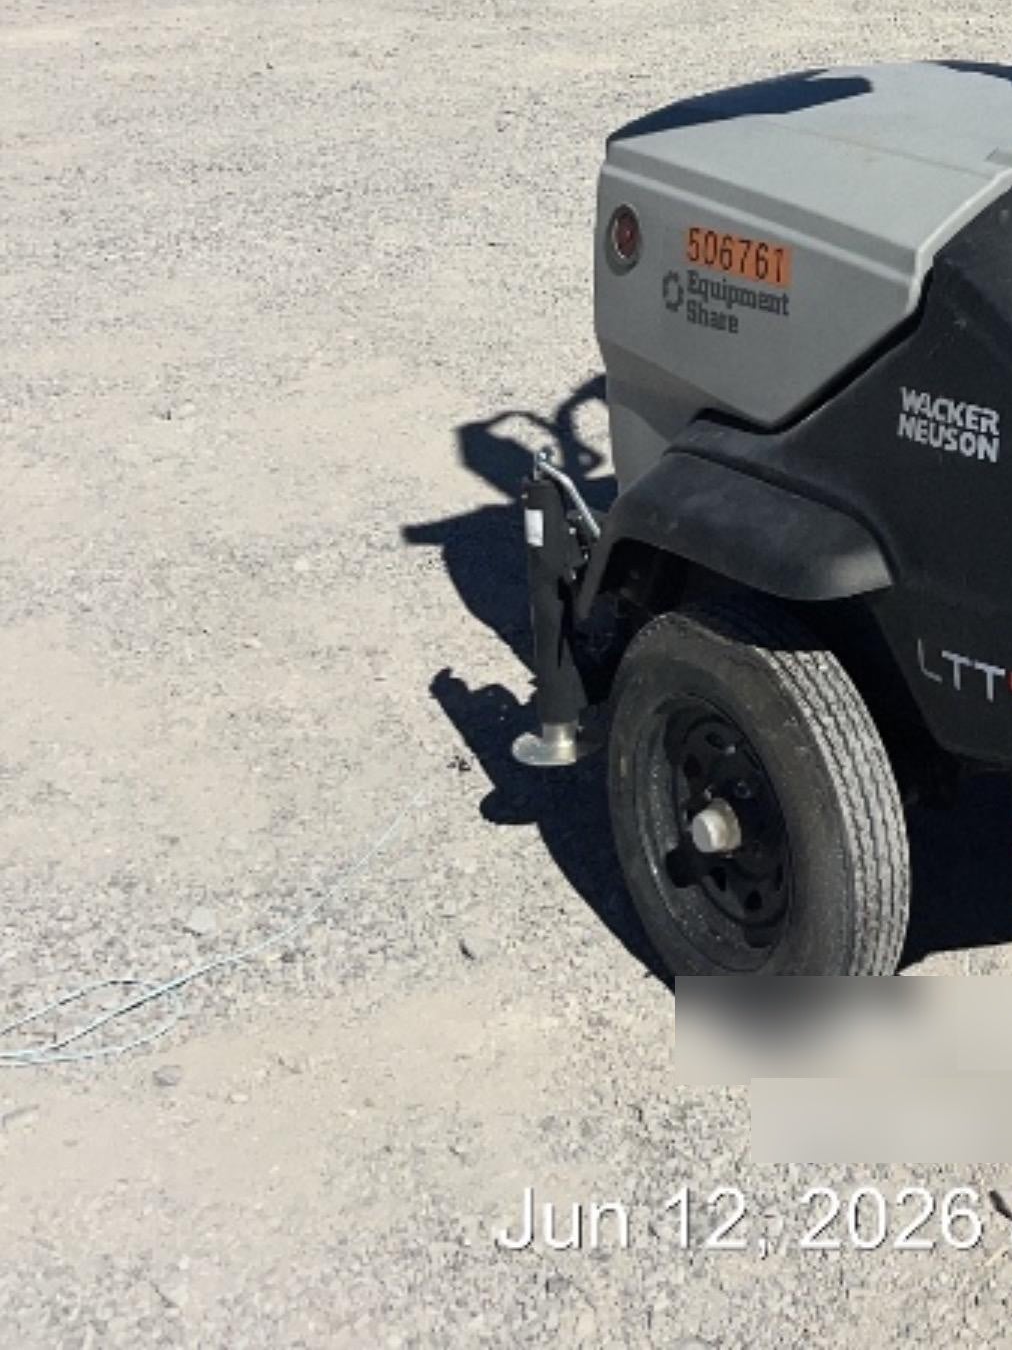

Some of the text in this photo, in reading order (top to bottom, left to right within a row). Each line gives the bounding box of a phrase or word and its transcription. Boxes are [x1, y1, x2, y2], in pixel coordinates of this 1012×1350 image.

[686, 227, 785, 284] 506761
[686, 269, 790, 317] Equipment
[686, 299, 740, 335] Share
[900, 386, 1000, 437] WACKER
[897, 412, 1000, 464] NEUSON
